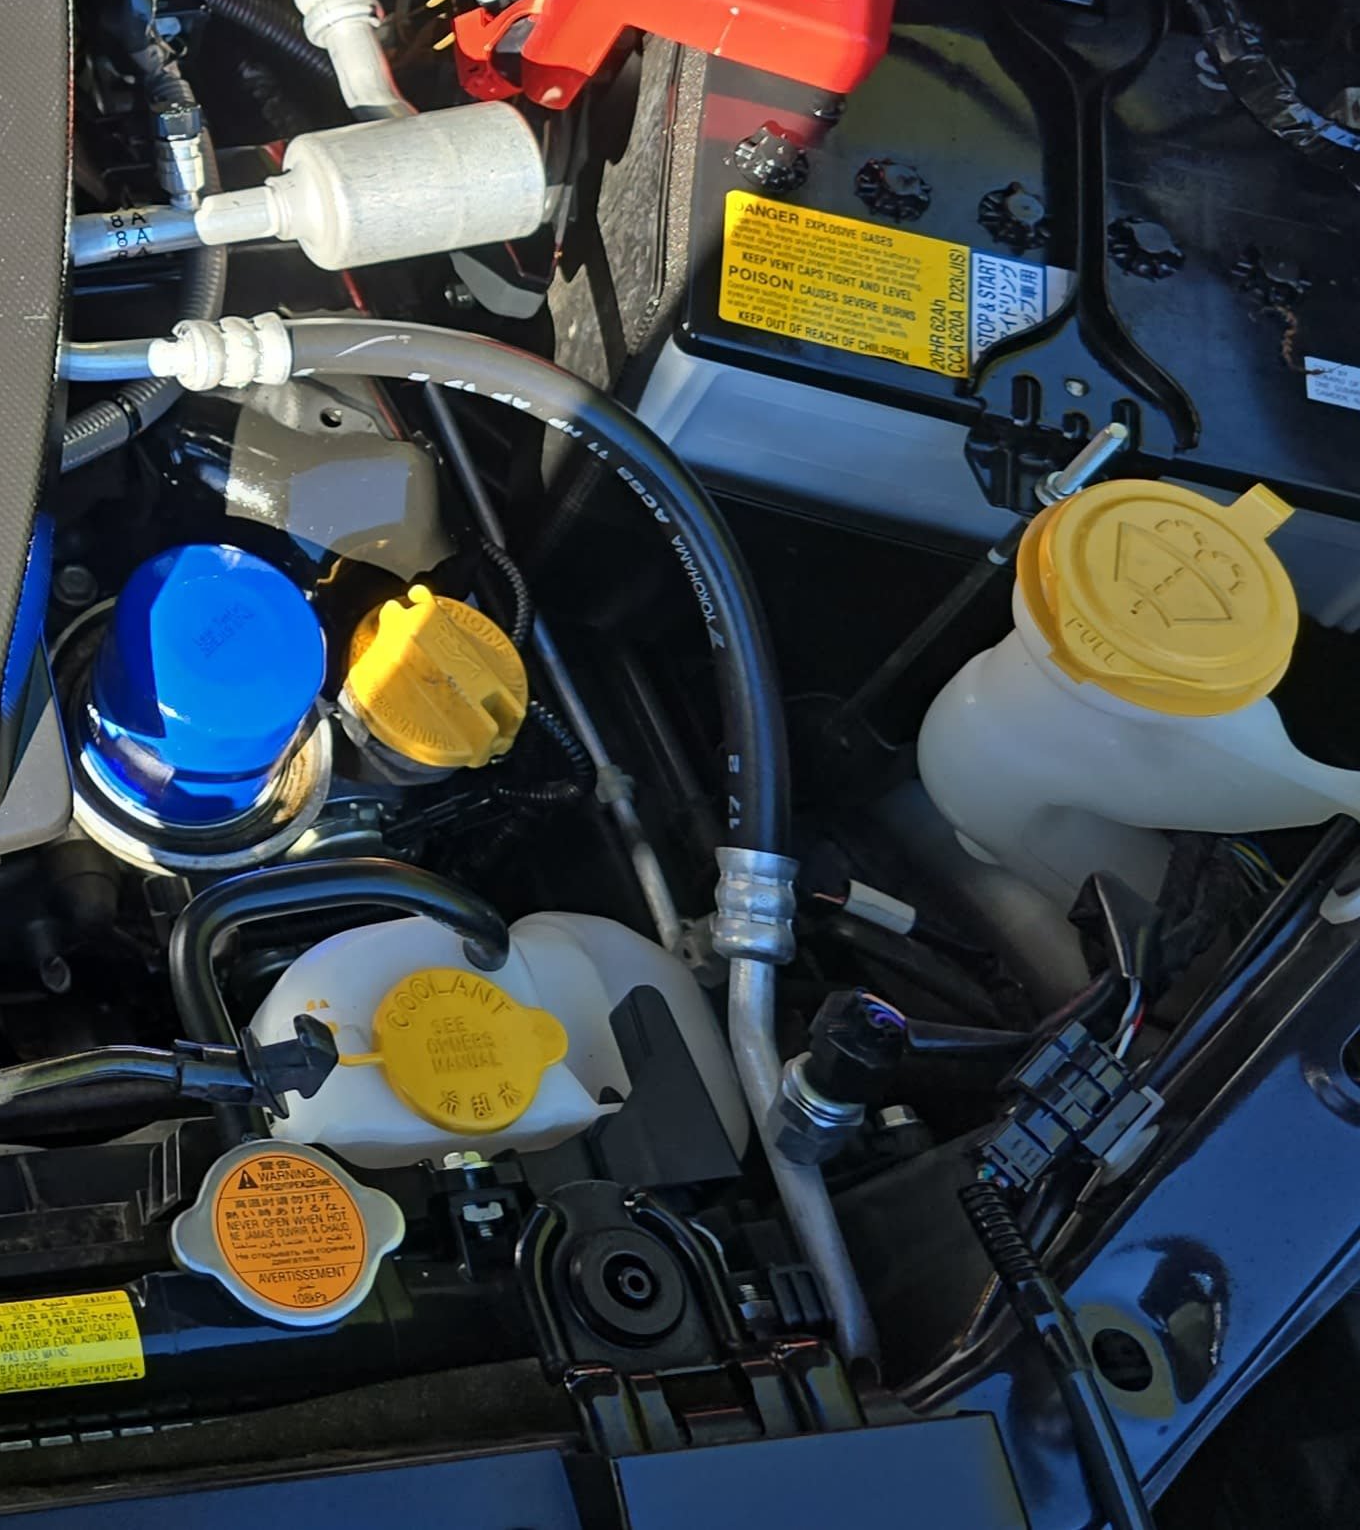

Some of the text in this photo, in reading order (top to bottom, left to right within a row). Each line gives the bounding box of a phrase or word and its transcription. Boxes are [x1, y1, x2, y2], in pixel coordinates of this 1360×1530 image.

[805, 219, 856, 239] EXPLOSIVE
[728, 265, 794, 291] POISON
[799, 286, 838, 302] CAUSES
[842, 295, 878, 312] SEVERE
[742, 252, 913, 301] KEEP VENT CAPS TIGHT AND LEVEL
[978, 258, 997, 347] STOP & START
[738, 311, 909, 361] KEEP OUT OF REACH OF CHILDREN
[931, 299, 946, 370] 20HR 62Ah
[947, 343, 964, 373] CCA
[671, 533, 719, 626] YOKOHAMA
[386, 973, 511, 1030] COOLANT
[258, 1169, 315, 1182] WARNING
[227, 1218, 258, 1230] NEVER
[263, 1217, 289, 1227] OPEN
[294, 1213, 323, 1225] WHEN
[258, 1266, 347, 1284] AVERTISSEMENT
